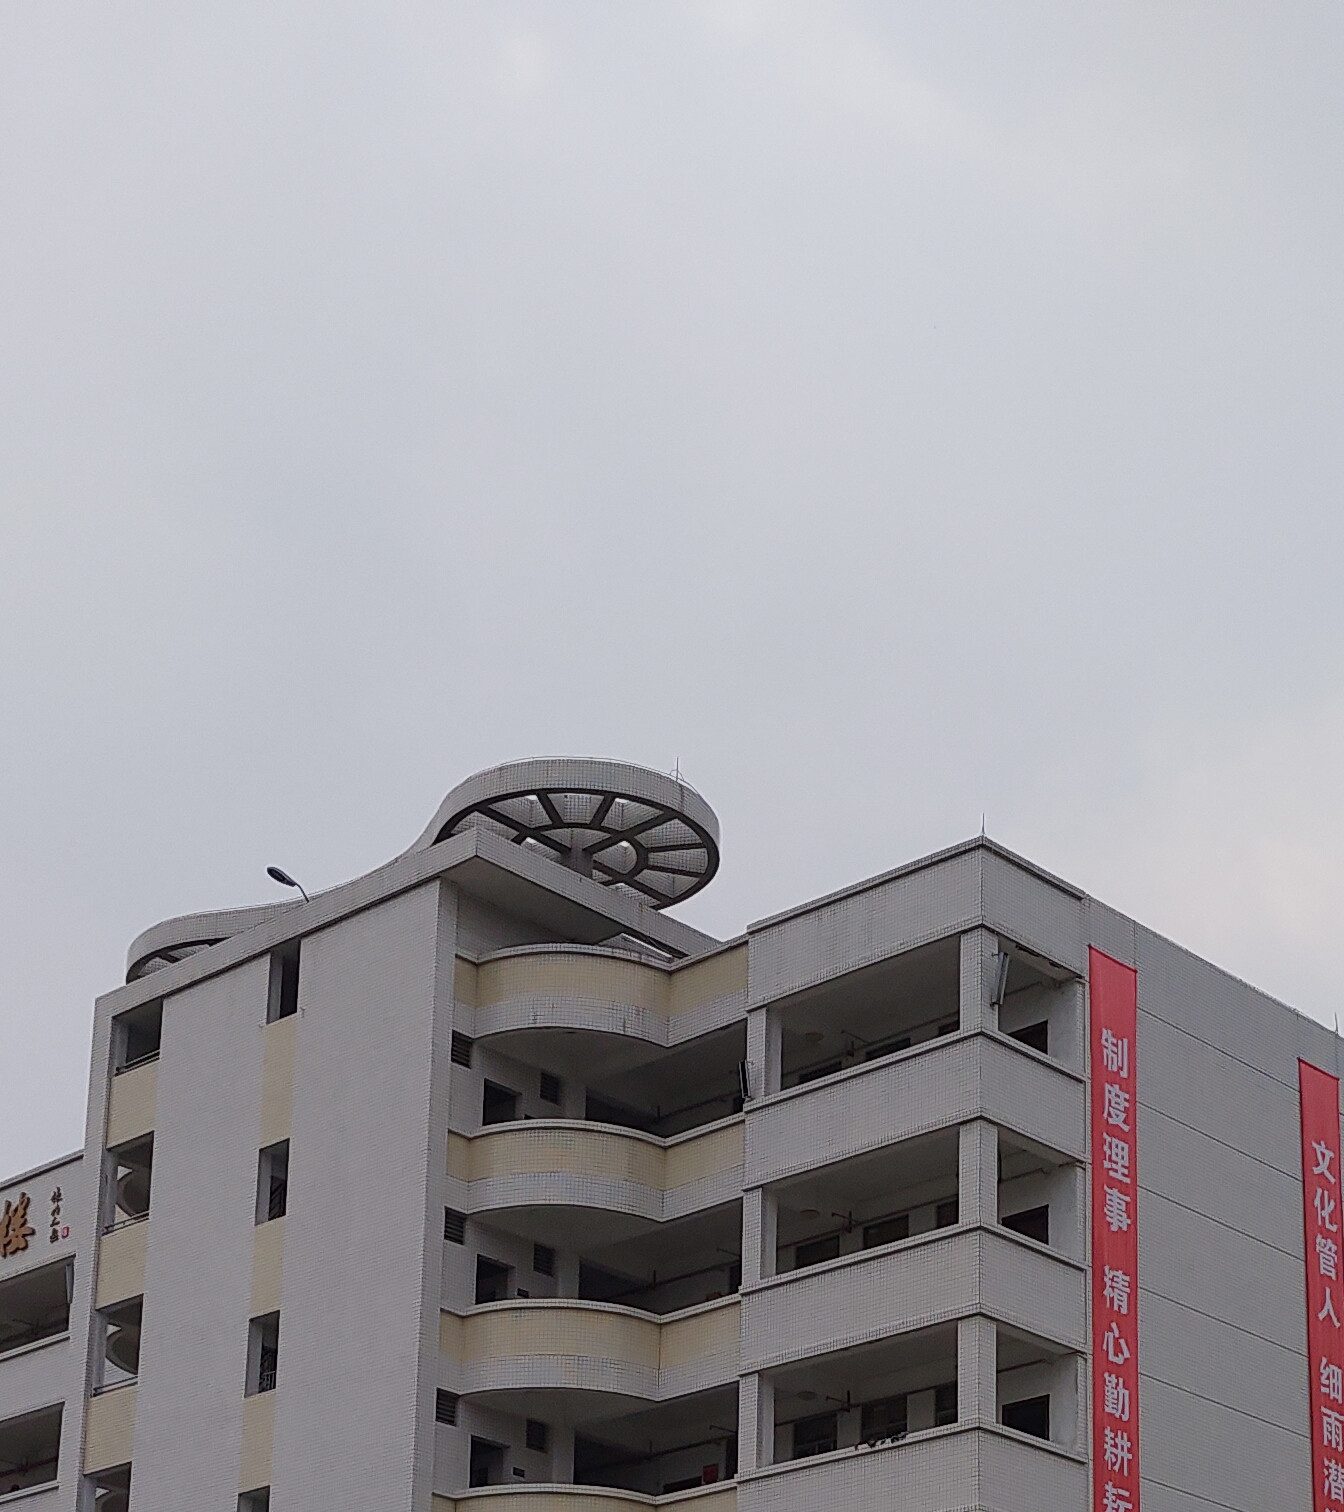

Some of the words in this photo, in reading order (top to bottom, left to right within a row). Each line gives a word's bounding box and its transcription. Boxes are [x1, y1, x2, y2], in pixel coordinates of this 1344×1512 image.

[1101, 1028, 1132, 1232] 制度理事
[1311, 1140, 1341, 1329] 文化管人
